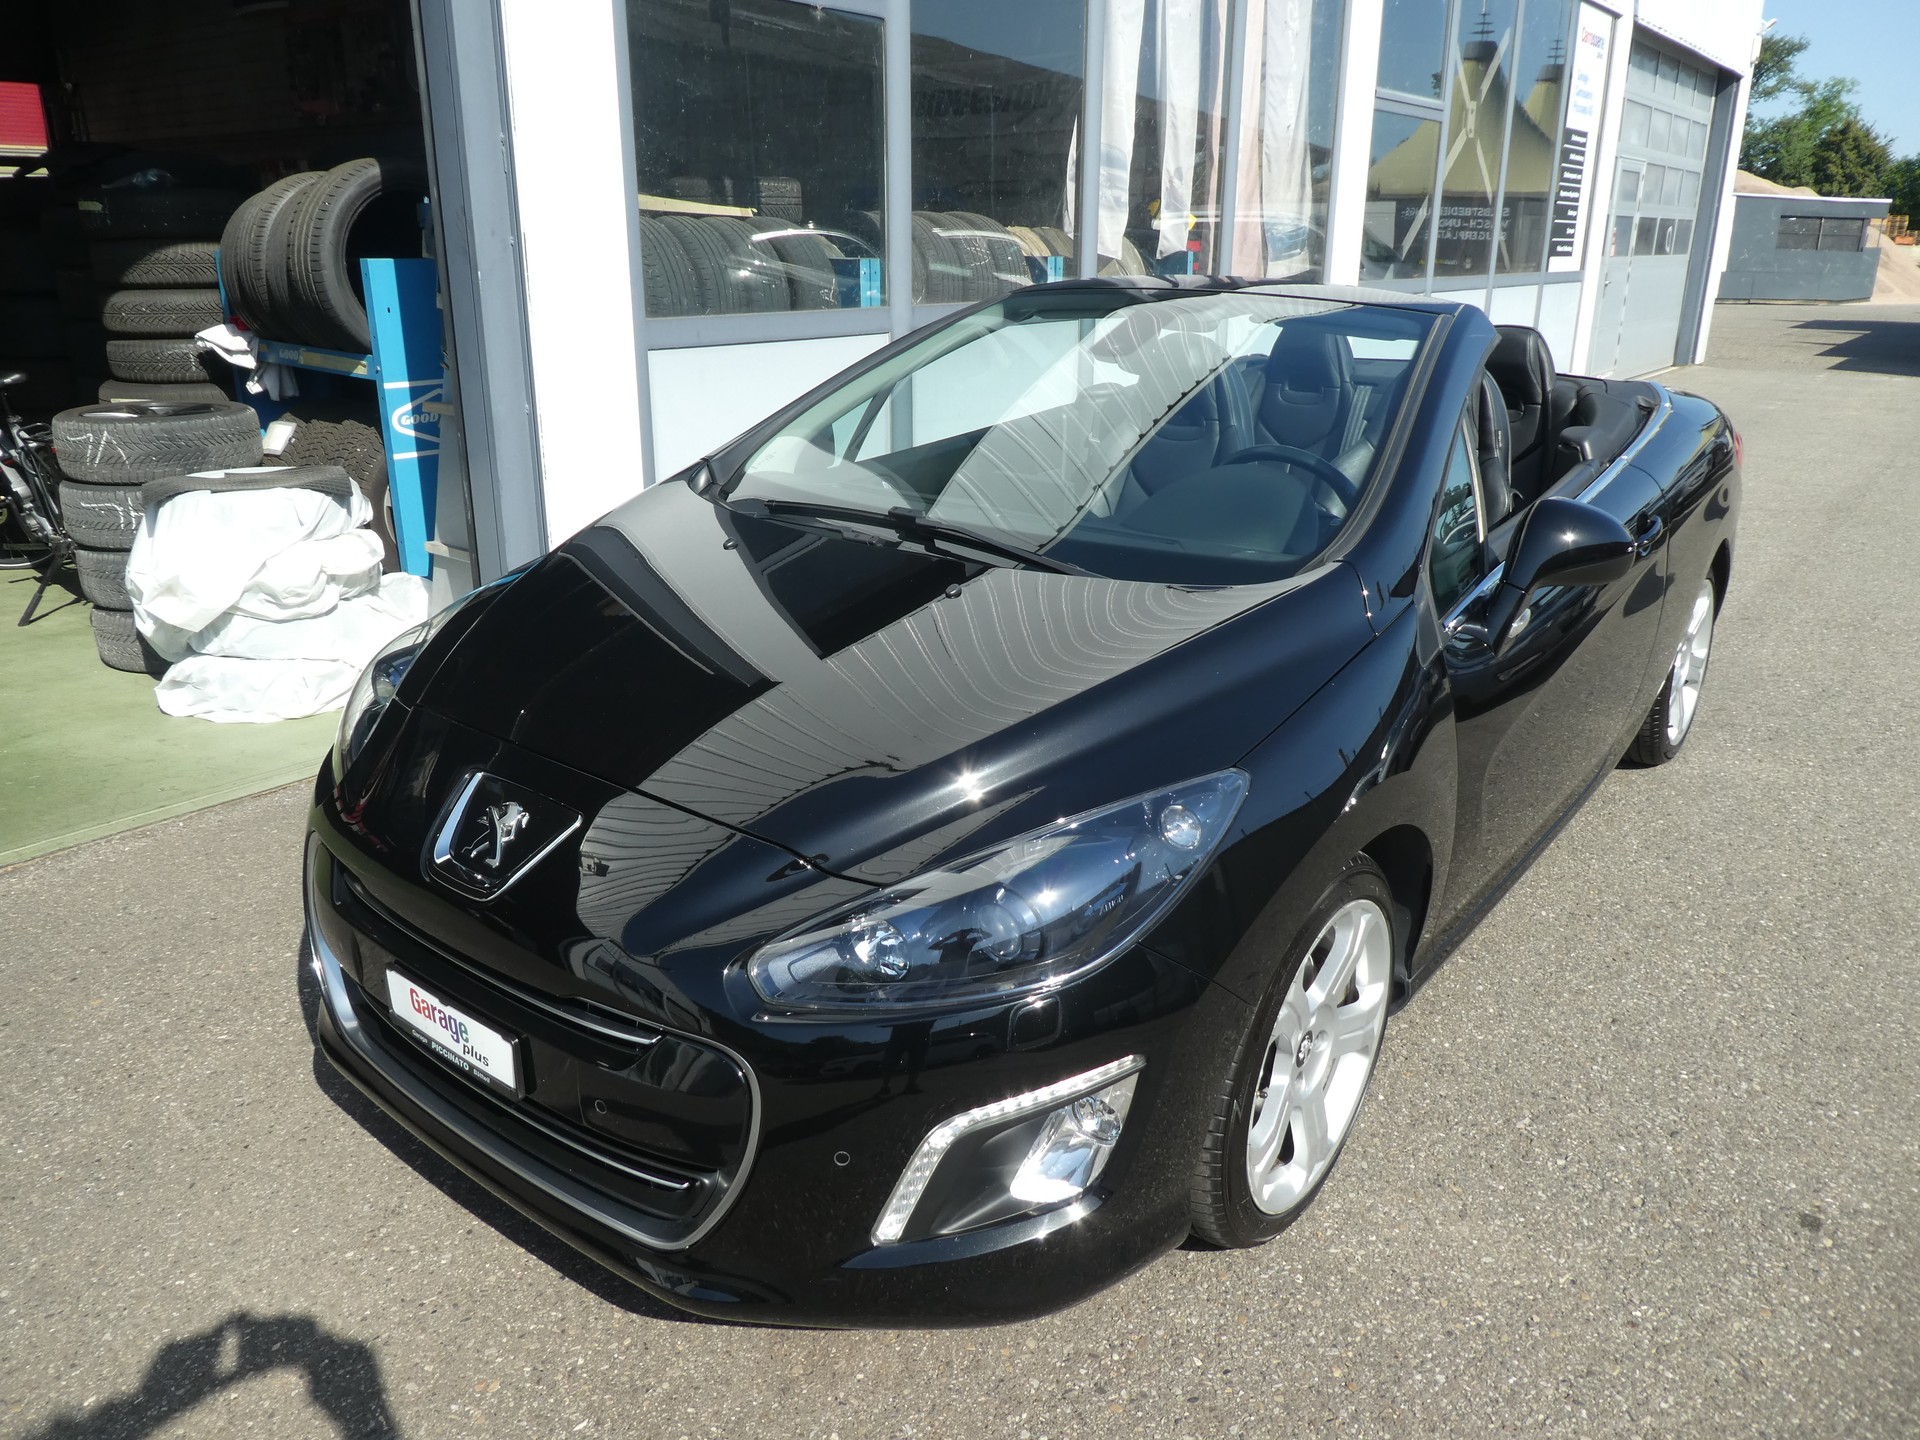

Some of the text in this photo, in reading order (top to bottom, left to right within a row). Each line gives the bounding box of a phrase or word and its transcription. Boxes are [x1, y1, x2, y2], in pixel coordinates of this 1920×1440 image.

[409, 987, 470, 1044] Garage
[431, 1041, 470, 1071] PICCINATO
[462, 1043, 489, 1067] plus
